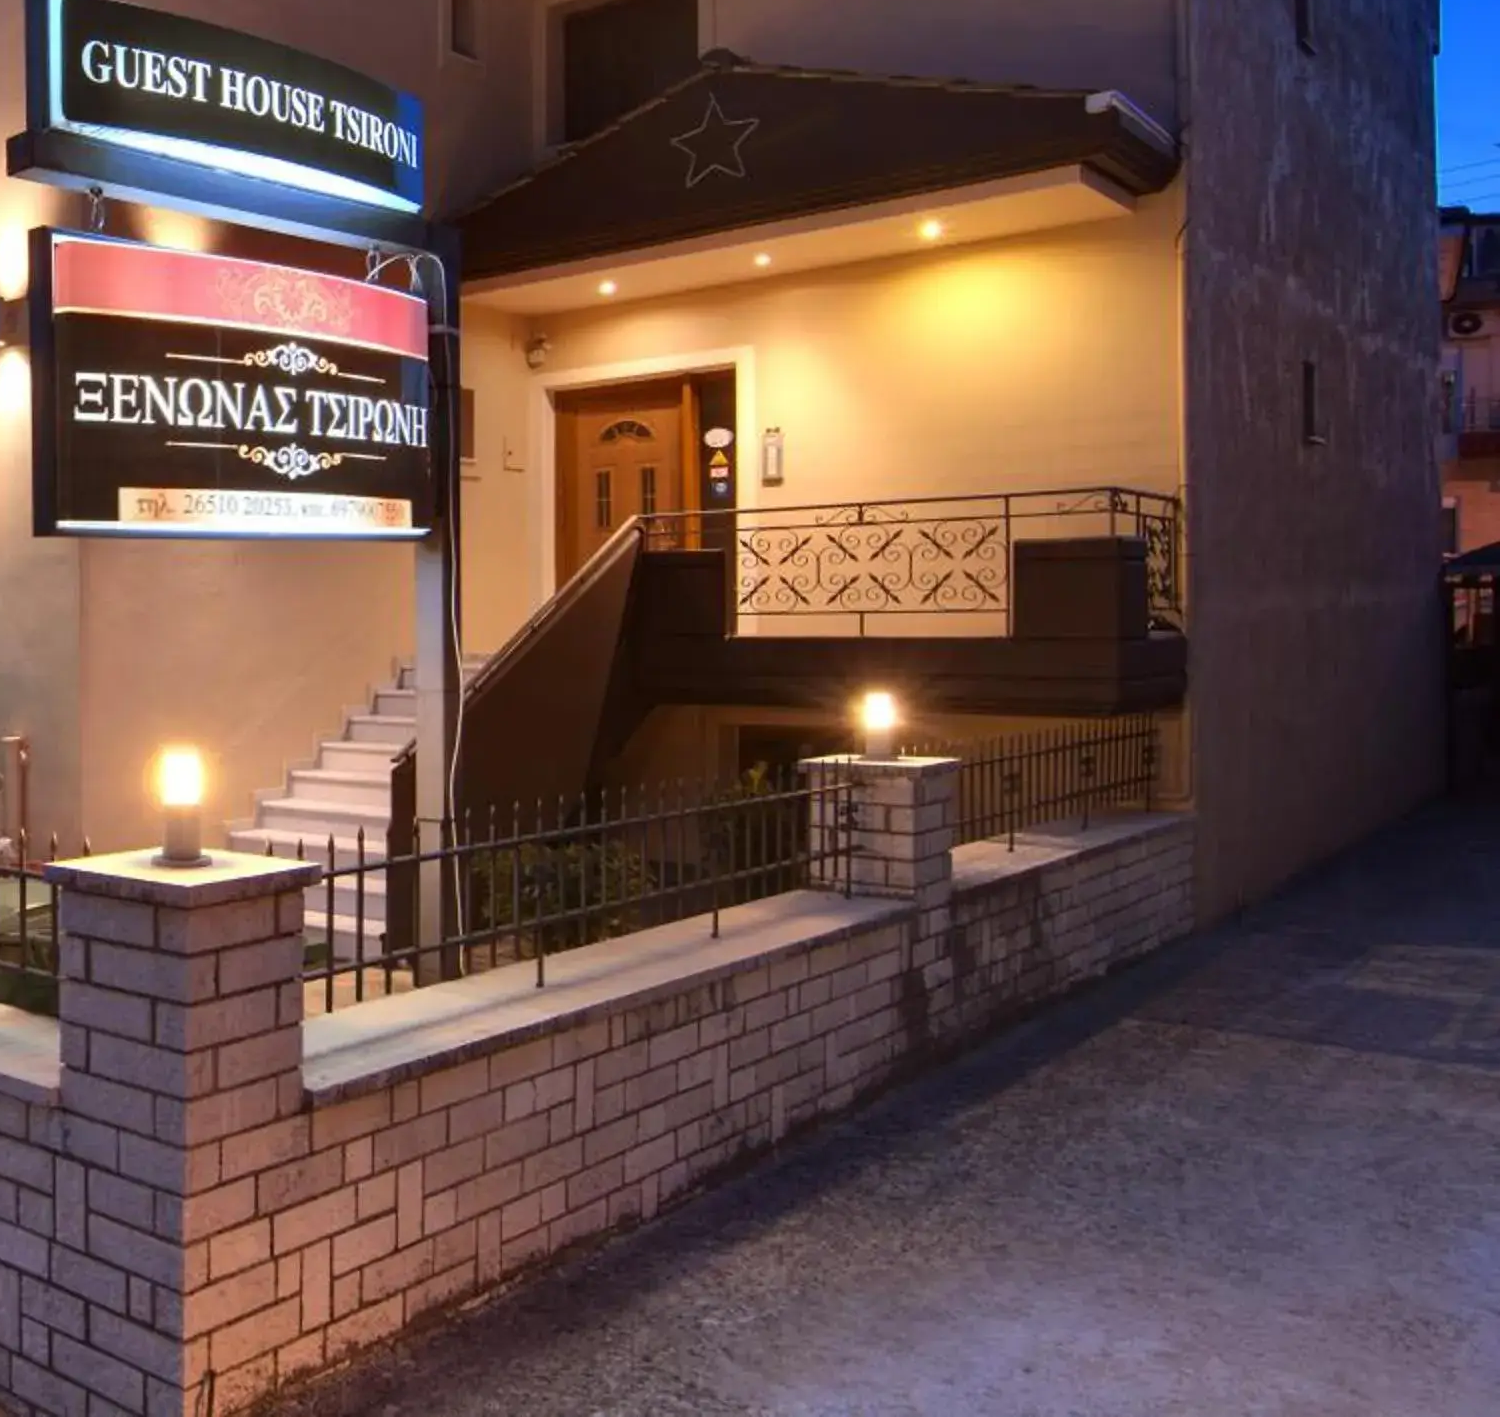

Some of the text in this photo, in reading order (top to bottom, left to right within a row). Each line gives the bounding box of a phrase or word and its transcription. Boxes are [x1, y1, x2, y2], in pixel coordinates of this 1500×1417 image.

[81, 39, 418, 169] GUEST HOUSE TSIRONI
[74, 371, 429, 448] ΞΕΝΩΝΑΣ ΤΣΙΡΩΝΗ
[183, 493, 238, 515] 26510
